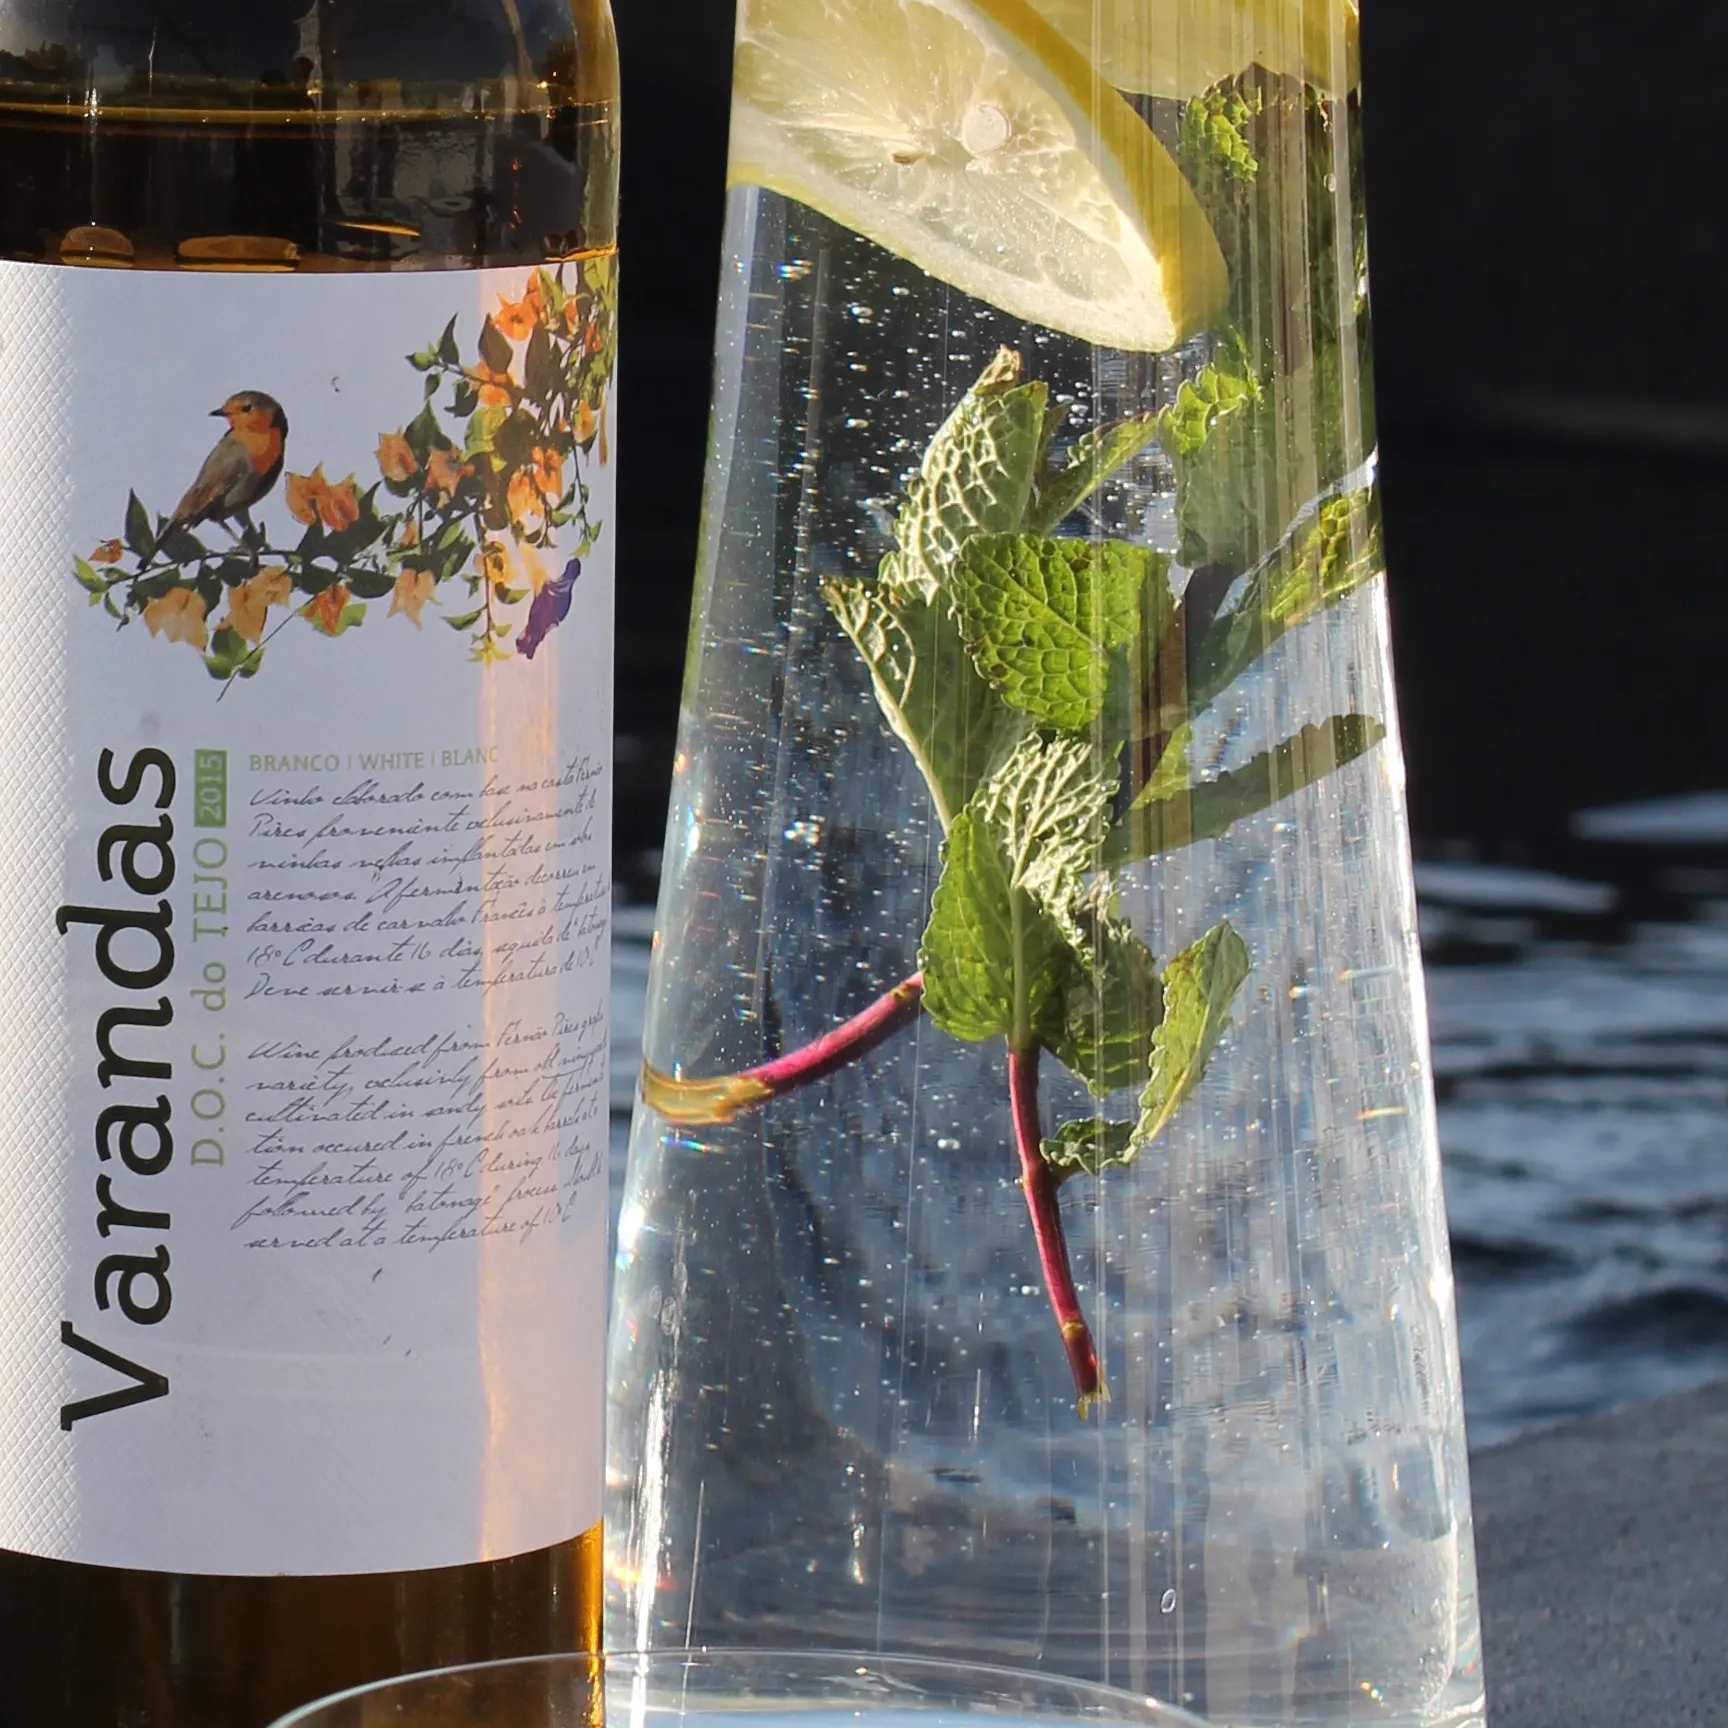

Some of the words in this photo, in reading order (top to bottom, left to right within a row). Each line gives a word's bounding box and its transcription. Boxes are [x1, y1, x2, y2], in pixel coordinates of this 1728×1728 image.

[197, 753, 222, 823] 2015
[248, 754, 340, 772] BRANCO
[359, 752, 425, 771] WHITE
[441, 745, 500, 768] BLANC
[192, 837, 228, 943] TEJO
[189, 961, 226, 1012] do
[56, 746, 177, 1432] Varandas
[190, 1032, 226, 1168] D.O.C.
